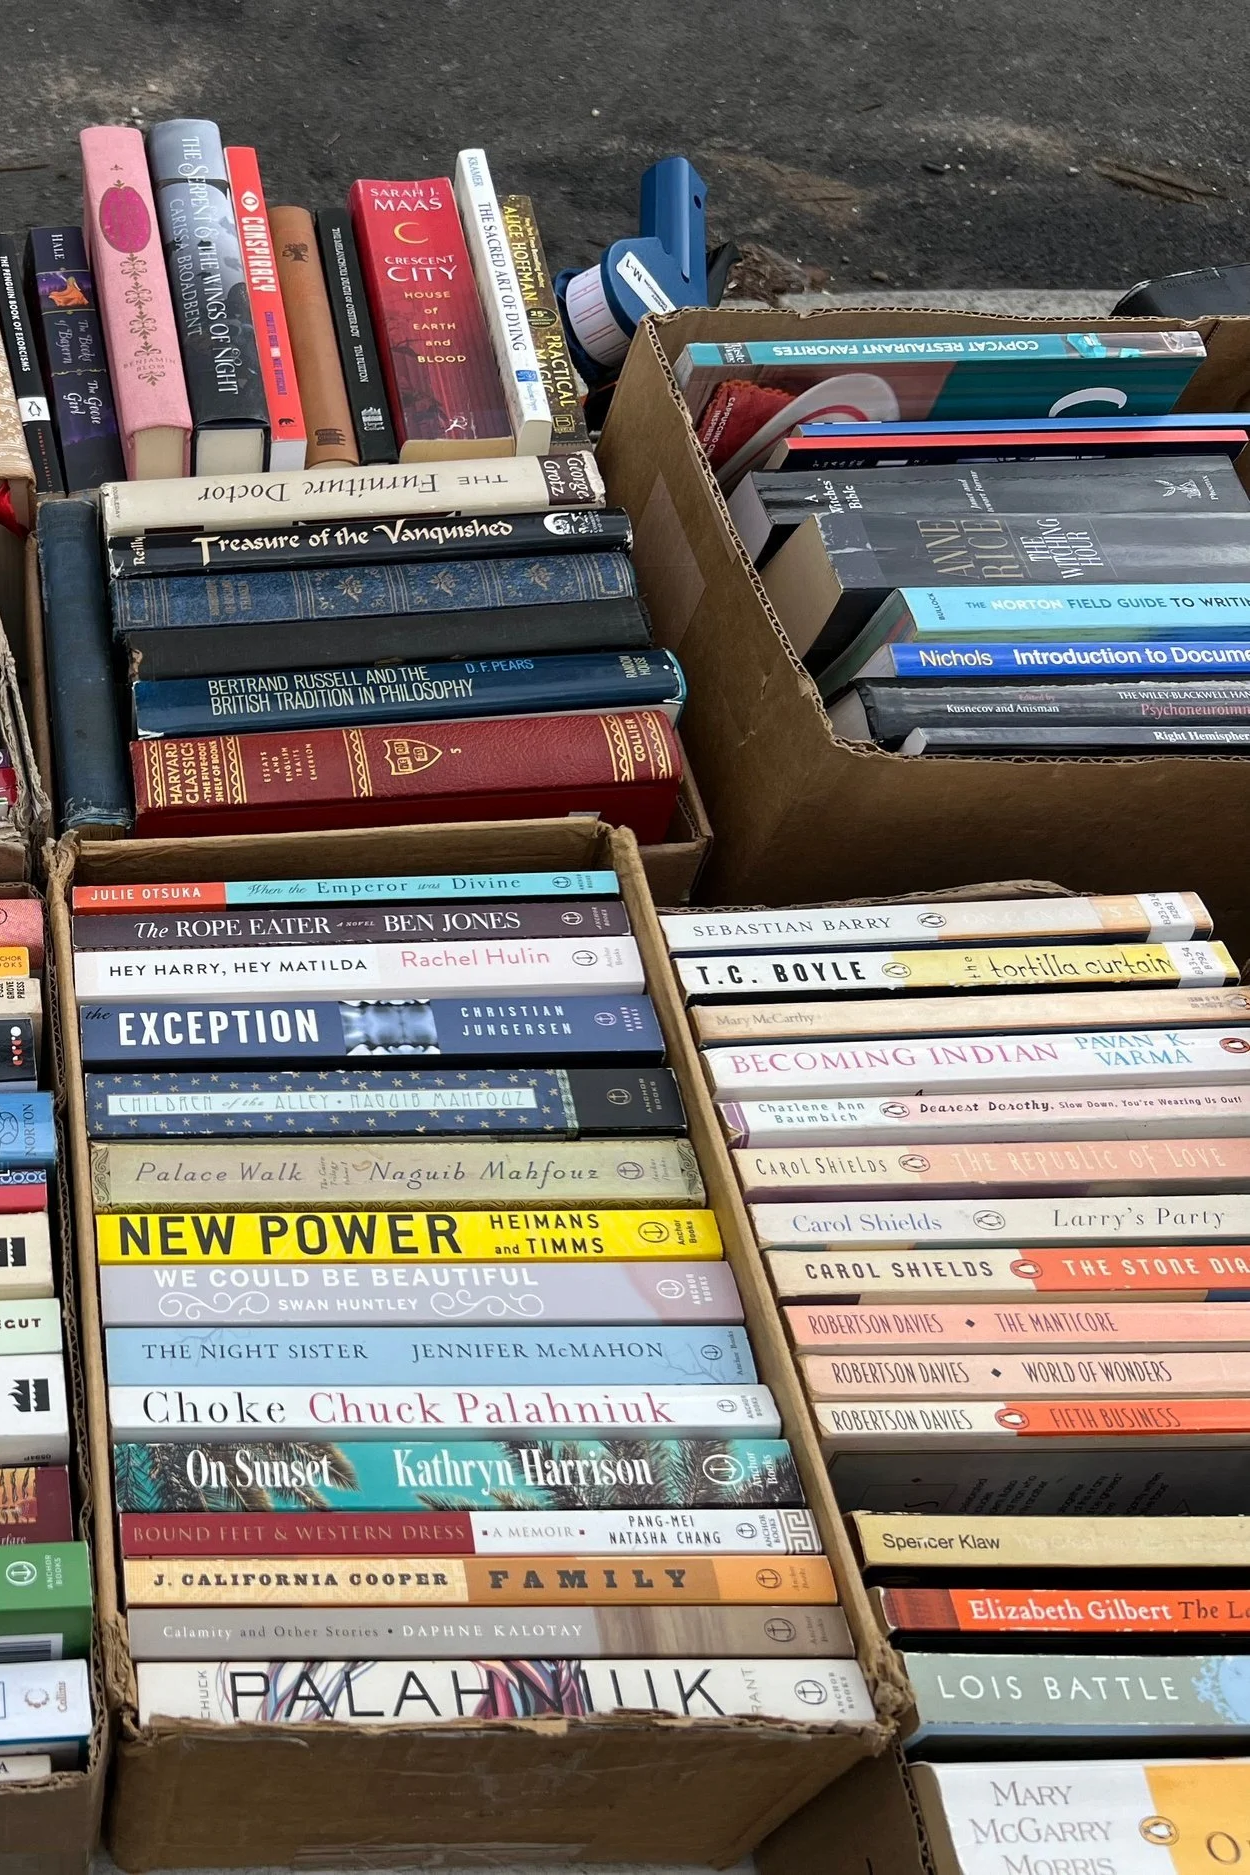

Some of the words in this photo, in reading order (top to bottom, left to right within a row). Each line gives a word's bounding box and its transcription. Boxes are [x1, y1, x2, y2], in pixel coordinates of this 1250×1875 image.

[467, 156, 485, 187] KRAMER
[370, 186, 424, 199] SARAH
[374, 197, 443, 212] MAAS
[169, 198, 189, 251] CARISSA
[503, 206, 523, 239] ALICE
[51, 234, 64, 260] HALE
[241, 217, 278, 293] CONSPIRACY
[384, 254, 454, 265] CRESCENT
[387, 265, 458, 284] CITY
[511, 241, 538, 302] HOFFMAN
[178, 255, 202, 337] BROADBENT
[771, 344, 845, 357] FAVORITES
[850, 342, 963, 353] RESTAURANT
[967, 338, 1040, 352] COPYCAT
[417, 354, 467, 364] BLOOD
[546, 335, 576, 408] PRACTICAL
[198, 478, 291, 503] Doctor
[304, 473, 438, 496] Furniture
[191, 533, 300, 566] Treasure
[309, 527, 330, 550] of
[334, 527, 368, 546] the
[372, 519, 513, 544] Vanquished
[991, 599, 1063, 610] NORTON
[1068, 598, 1112, 609] FIELD
[1117, 598, 1168, 608] GUIDE
[920, 650, 994, 667] Nichols
[1014, 647, 1140, 666] Introduction
[947, 704, 992, 714] Kusnecov
[996, 704, 1013, 713] and
[1016, 703, 1060, 713] Anisman
[625, 719, 646, 762] COLLIER
[165, 742, 183, 805] HARVARD
[181, 743, 200, 804] CLASSICS
[90, 888, 136, 900] JULIE
[142, 886, 201, 900] OTSUKA
[153, 961, 226, 978] HARRY,
[234, 960, 271, 974] HEY
[279, 957, 368, 972] MATILDA
[696, 964, 759, 986] T.C.
[772, 960, 866, 984] BOYLE
[989, 955, 1080, 979] tortilla
[460, 1004, 565, 1019] CHRISTIAN
[118, 1008, 320, 1046] EXCEPTION
[462, 1021, 573, 1036] JUNGERSEN
[734, 1048, 915, 1075] BECOMING
[926, 1042, 1059, 1067] INDIAN
[757, 1102, 830, 1115] Charlene
[836, 1101, 866, 1112] Ann
[1059, 1100, 1084, 1109] Slow
[1158, 1097, 1202, 1108] Wearing
[774, 1110, 858, 1125] Baumbich
[792, 1215, 852, 1234] Carol
[860, 1211, 942, 1233] Shields
[119, 1216, 234, 1256] NEW
[262, 1213, 461, 1255] POWER
[411, 1341, 529, 1362] JENNIFER
[538, 1342, 663, 1358] McMAHON
[394, 1448, 513, 1495] Kathryn
[523, 1449, 652, 1486] Harrison
[628, 1514, 695, 1529] PANG-MEI
[609, 1529, 669, 1545] NATASHA
[677, 1528, 721, 1544] CHANG
[882, 1535, 953, 1552] Spencer
[959, 1532, 1000, 1551] Klaw
[489, 1568, 689, 1589] FAMILY
[970, 1600, 1084, 1621] Elizabeth
[1090, 1599, 1172, 1621] Gilbert
[937, 1676, 1023, 1700] LOIS
[1044, 1675, 1180, 1700] BATTLE
